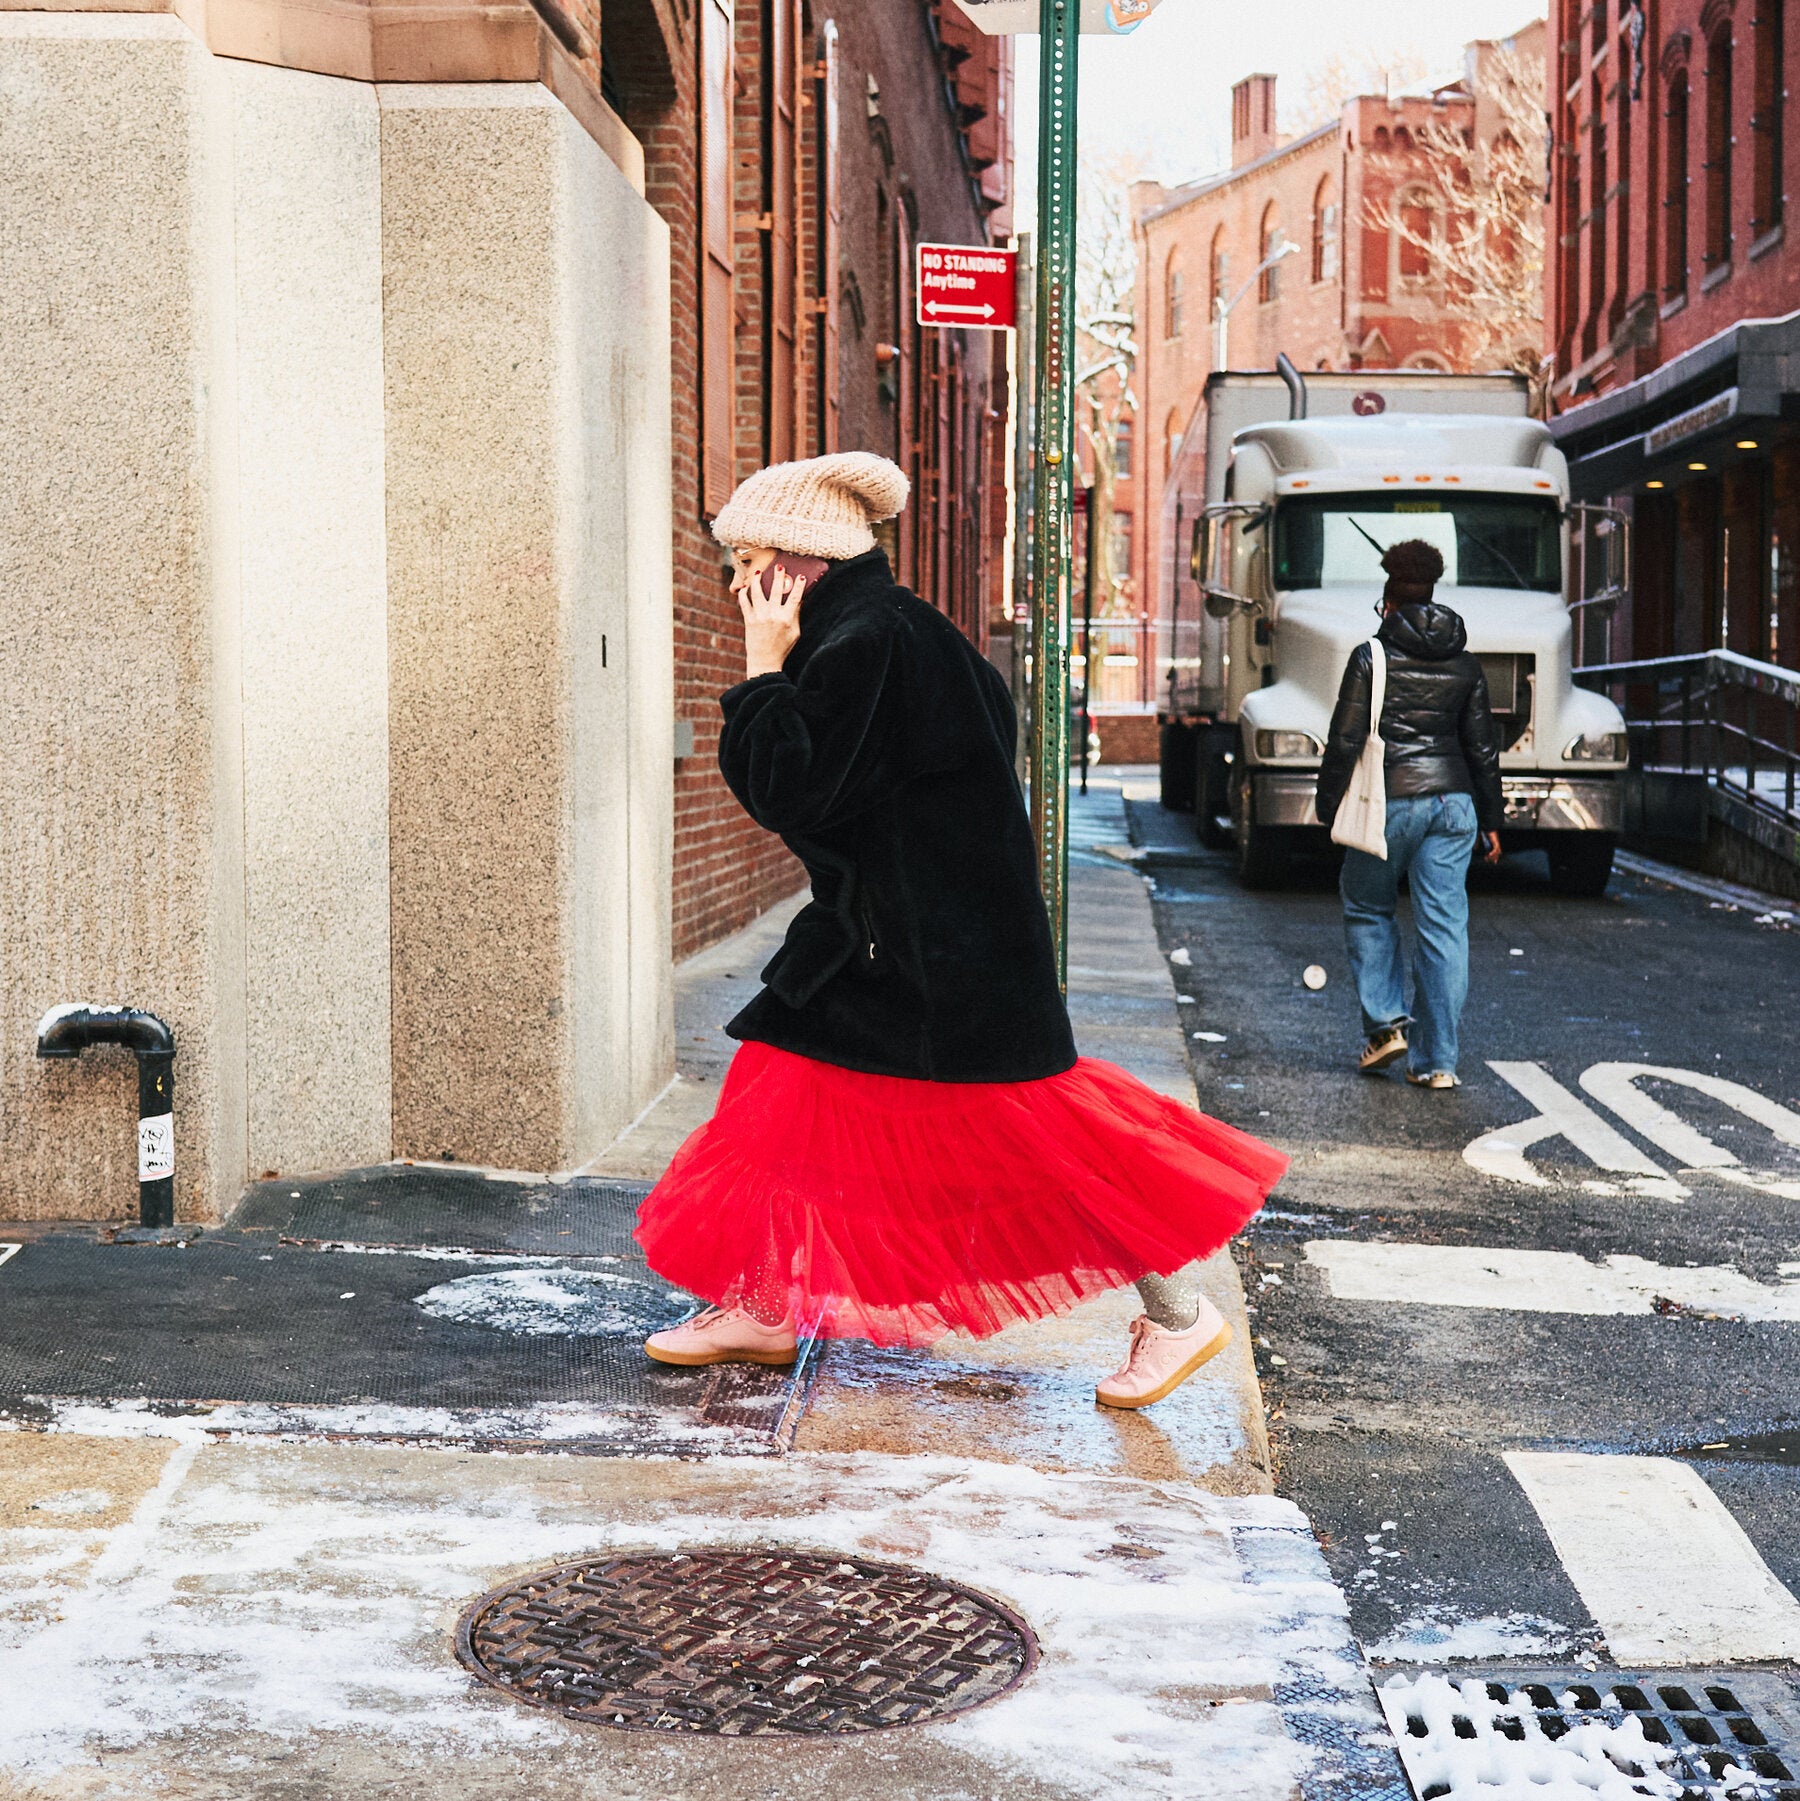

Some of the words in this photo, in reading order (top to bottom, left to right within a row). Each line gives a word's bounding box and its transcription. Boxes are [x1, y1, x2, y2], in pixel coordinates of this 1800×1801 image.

[923, 253, 942, 270] NO
[944, 254, 1007, 274] STANDING
[924, 272, 977, 291] Anytime
